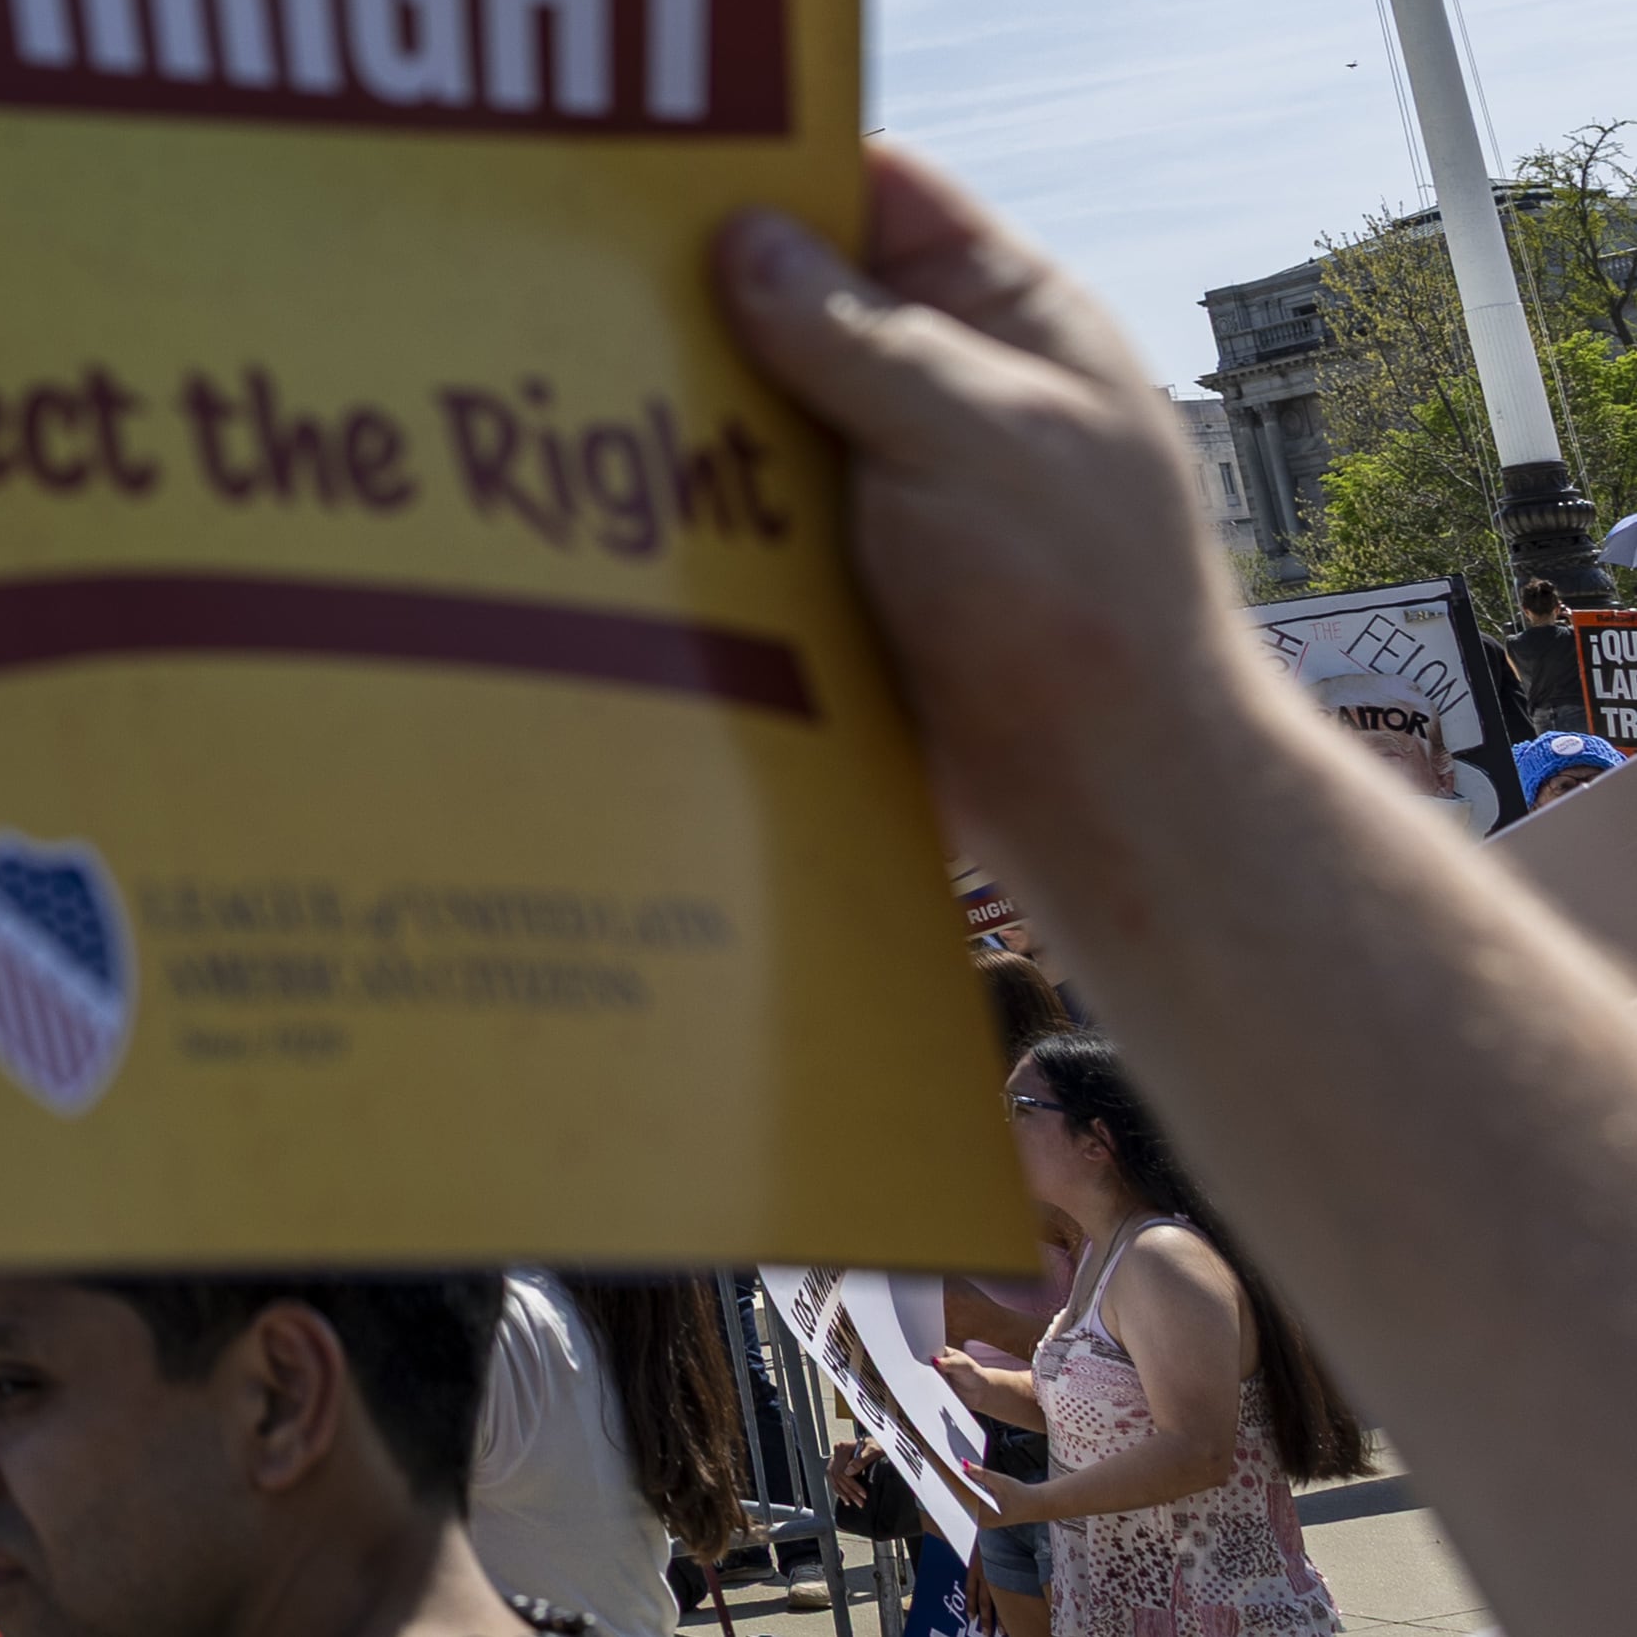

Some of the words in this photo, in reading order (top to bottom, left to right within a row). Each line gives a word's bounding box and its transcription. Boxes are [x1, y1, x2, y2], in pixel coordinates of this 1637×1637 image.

[178, 363, 418, 519] the
[437, 377, 792, 558] Right
[1309, 621, 1343, 641] THE
[1346, 613, 1469, 716] FELON
[1335, 705, 1430, 739] AITOR
[967, 898, 1015, 925] RIGH
